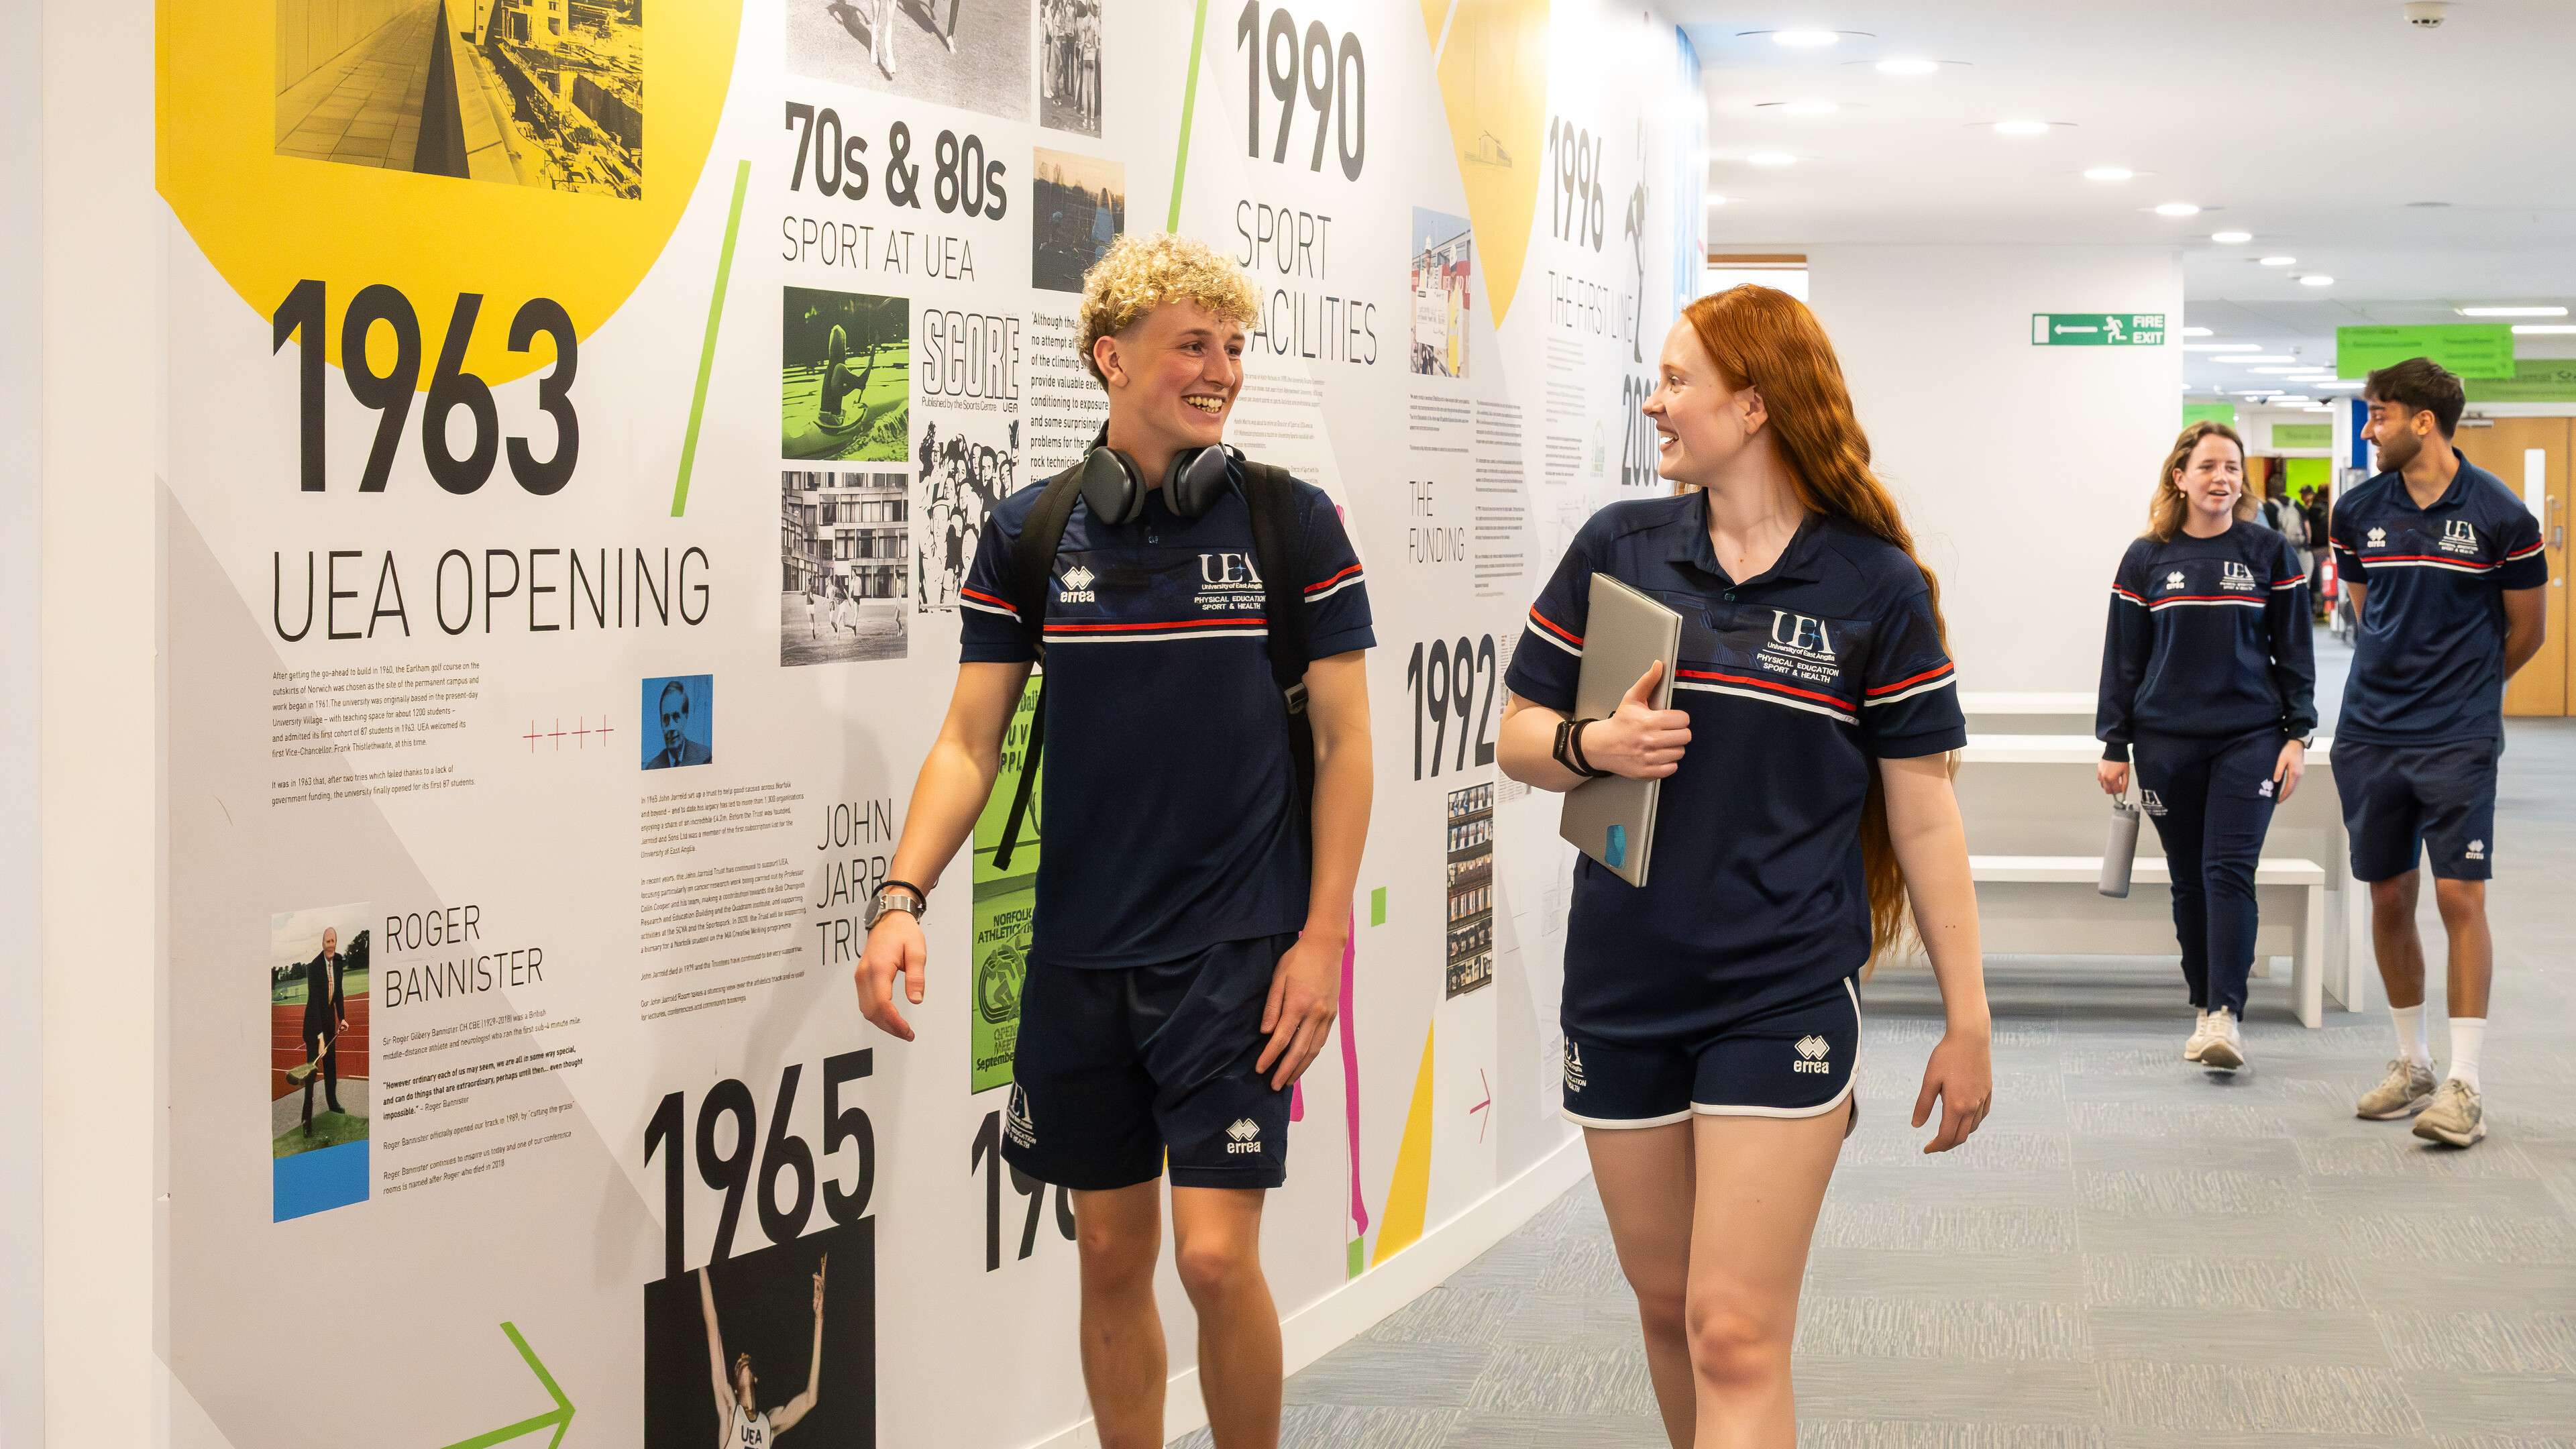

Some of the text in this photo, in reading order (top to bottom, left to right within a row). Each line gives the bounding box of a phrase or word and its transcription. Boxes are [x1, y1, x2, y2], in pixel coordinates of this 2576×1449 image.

[1238, 0, 1365, 182] 1990
[786, 101, 1007, 221] 70s & 80s
[1550, 115, 1604, 253] 1996
[782, 216, 975, 282] SPORT AT UEA
[1236, 200, 1332, 280] SPORT
[1548, 270, 1632, 343] THE FIRST LINE
[1065, 315, 1075, 329] the
[1250, 286, 1377, 366] ACILITIES
[2133, 315, 2164, 328] FIRE
[1031, 336, 1040, 346] no
[1041, 335, 1067, 349] attempt
[2133, 331, 2163, 344] EXIT
[922, 309, 1020, 400] SCORE
[1031, 354, 1038, 366] of
[1040, 355, 1050, 367] the
[1051, 355, 1079, 372] climbing
[273, 279, 579, 496] 1963
[1031, 375, 1103, 391] provide valuable exerc
[922, 396, 947, 409] Published
[947, 400, 953, 411] by
[954, 400, 963, 409] the
[963, 400, 979, 411] Sports
[1003, 402, 1018, 413] UEA
[1030, 396, 1109, 414] conditioning to exposure
[1030, 417, 1102, 433] and some surprisingly
[1030, 436, 1062, 451] problems
[1063, 437, 1073, 448] for
[1073, 437, 1085, 448] the
[1030, 456, 1045, 468] rock
[1409, 481, 1434, 517] THE
[1409, 527, 1464, 564] FUNDING
[1197, 553, 1263, 583] UEA
[274, 546, 710, 642] UEA OPENING
[1194, 595, 1266, 604] PHYSICAL EDUCATION
[1772, 610, 1836, 655] UEA
[1767, 641, 1796, 655] University
[1803, 650, 1816, 659] East
[272, 672, 288, 681] After
[288, 671, 310, 681] getting
[311, 669, 321, 678] the
[321, 668, 350, 679] go-ahead
[357, 667, 372, 675] build
[372, 665, 378, 674] in
[395, 665, 405, 673] the
[431, 663, 442, 673] golf
[1756, 653, 1839, 678] PHYSICAL EDUCATION
[1763, 663, 1790, 675] SPORT
[1801, 672, 1831, 684] HEALTH
[272, 688, 299, 696] outskirts
[300, 686, 307, 694] of
[307, 684, 332, 693] Norwich
[415, 678, 445, 688] permanent
[1407, 633, 1496, 782] 1992
[817, 798, 892, 851] JOHN
[816, 855, 895, 909] JARR
[994, 908, 1032, 928] NORFOLK
[386, 905, 480, 953] ROGER
[816, 916, 862, 966] TRU
[386, 947, 543, 1008] BANNISTER
[994, 1038, 1016, 1057] MEET
[977, 1052, 1015, 1073] Septembe
[1793, 1060, 1830, 1074] errea
[382, 1097, 394, 1105] and
[414, 1088, 433, 1098] things
[433, 1087, 445, 1095] that
[496, 1072, 518, 1084] perhaps
[519, 1068, 531, 1077] until
[563, 1058, 583, 1068] thought
[412, 1075, 437, 1084] ordinary
[437, 1071, 451, 1079] each
[451, 1068, 458, 1076] of
[466, 1065, 478, 1073] may
[1227, 1141, 1261, 1154] errea
[644, 1047, 875, 1278] 1965
[741, 1425, 763, 1446] UEA
